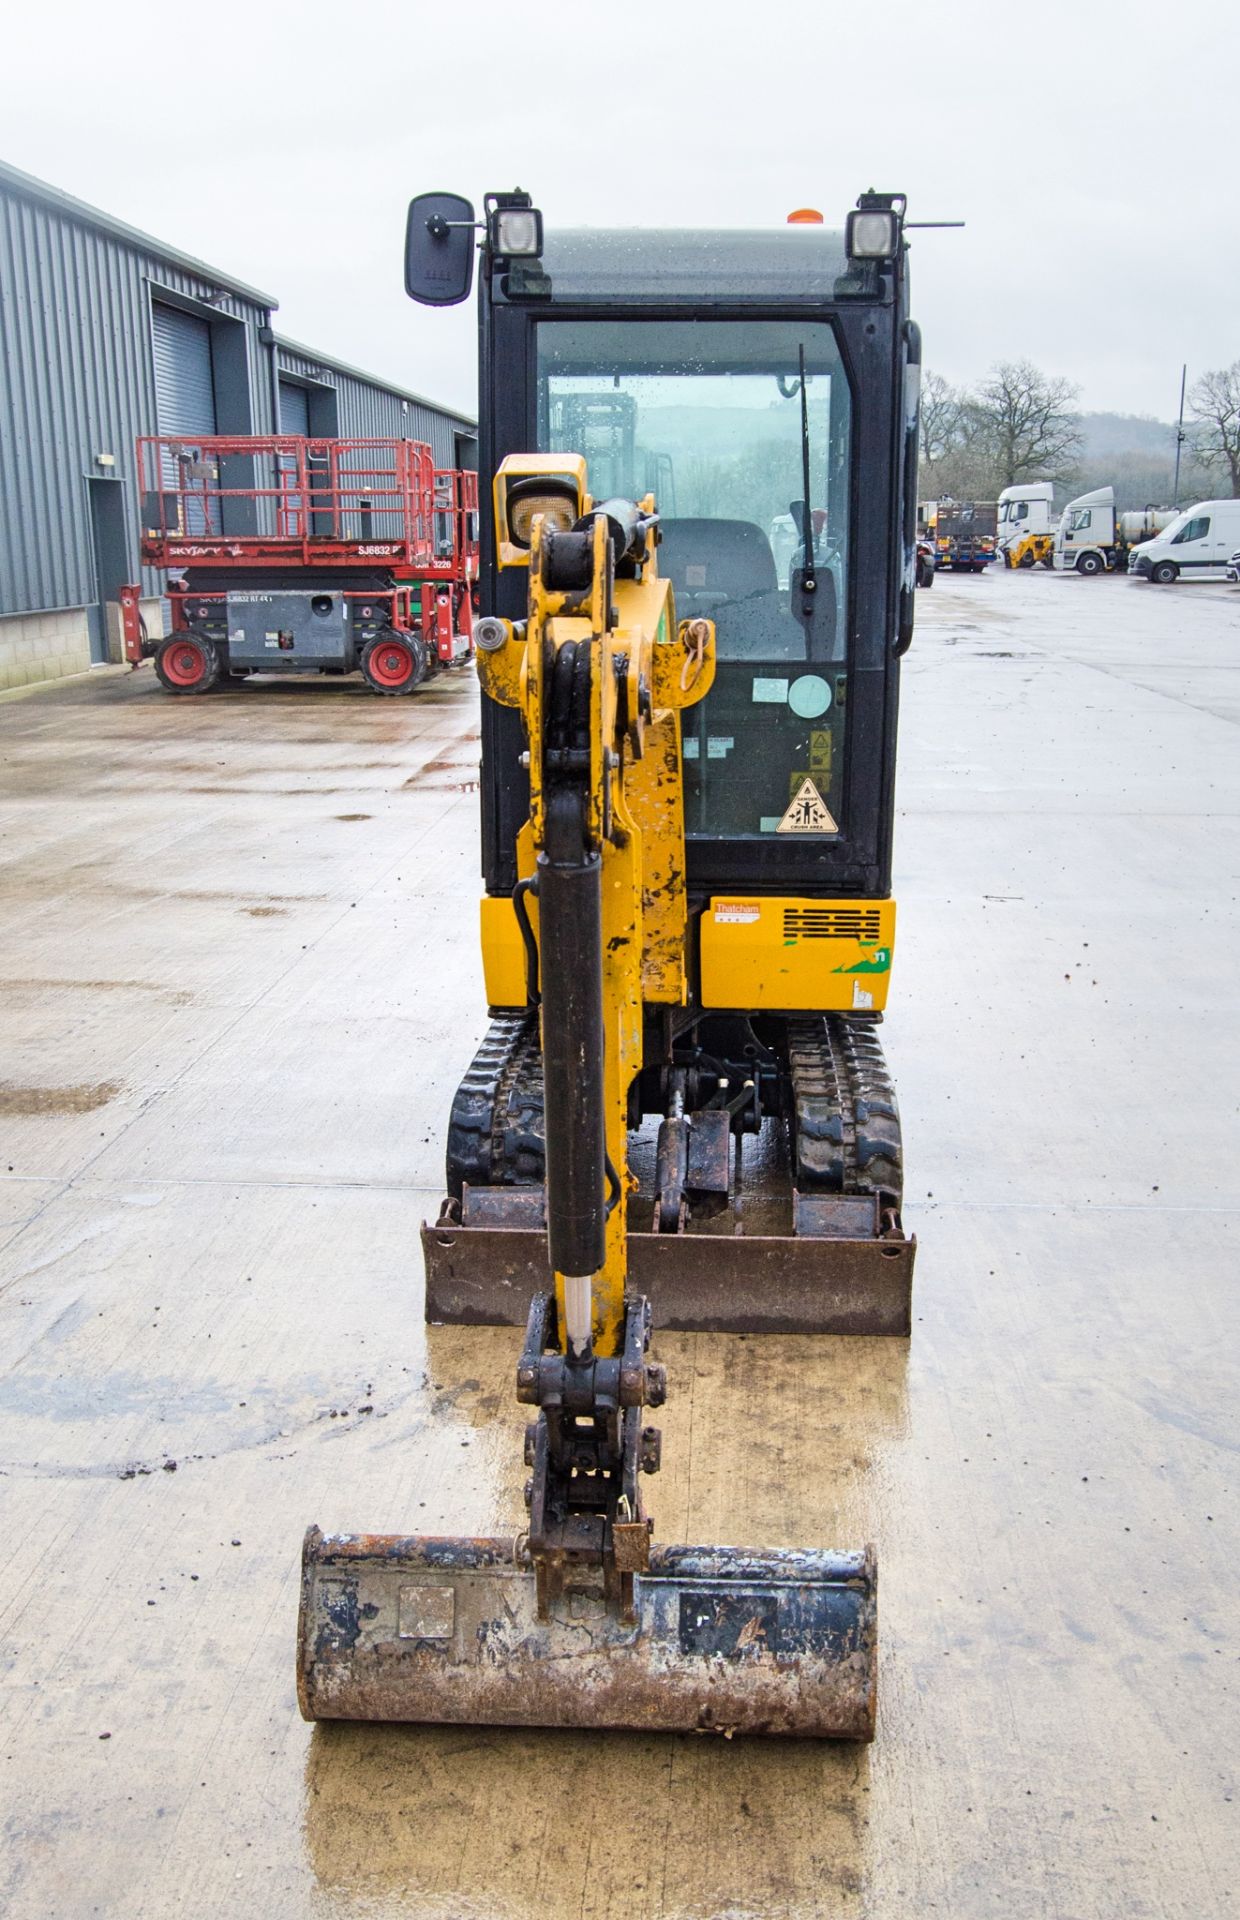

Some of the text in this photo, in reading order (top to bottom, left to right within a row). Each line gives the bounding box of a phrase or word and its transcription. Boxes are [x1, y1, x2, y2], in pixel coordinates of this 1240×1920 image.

[358, 545, 390, 555] SJ6832
[433, 560, 451, 569] 3226
[716, 903, 759, 913] Thatcham
